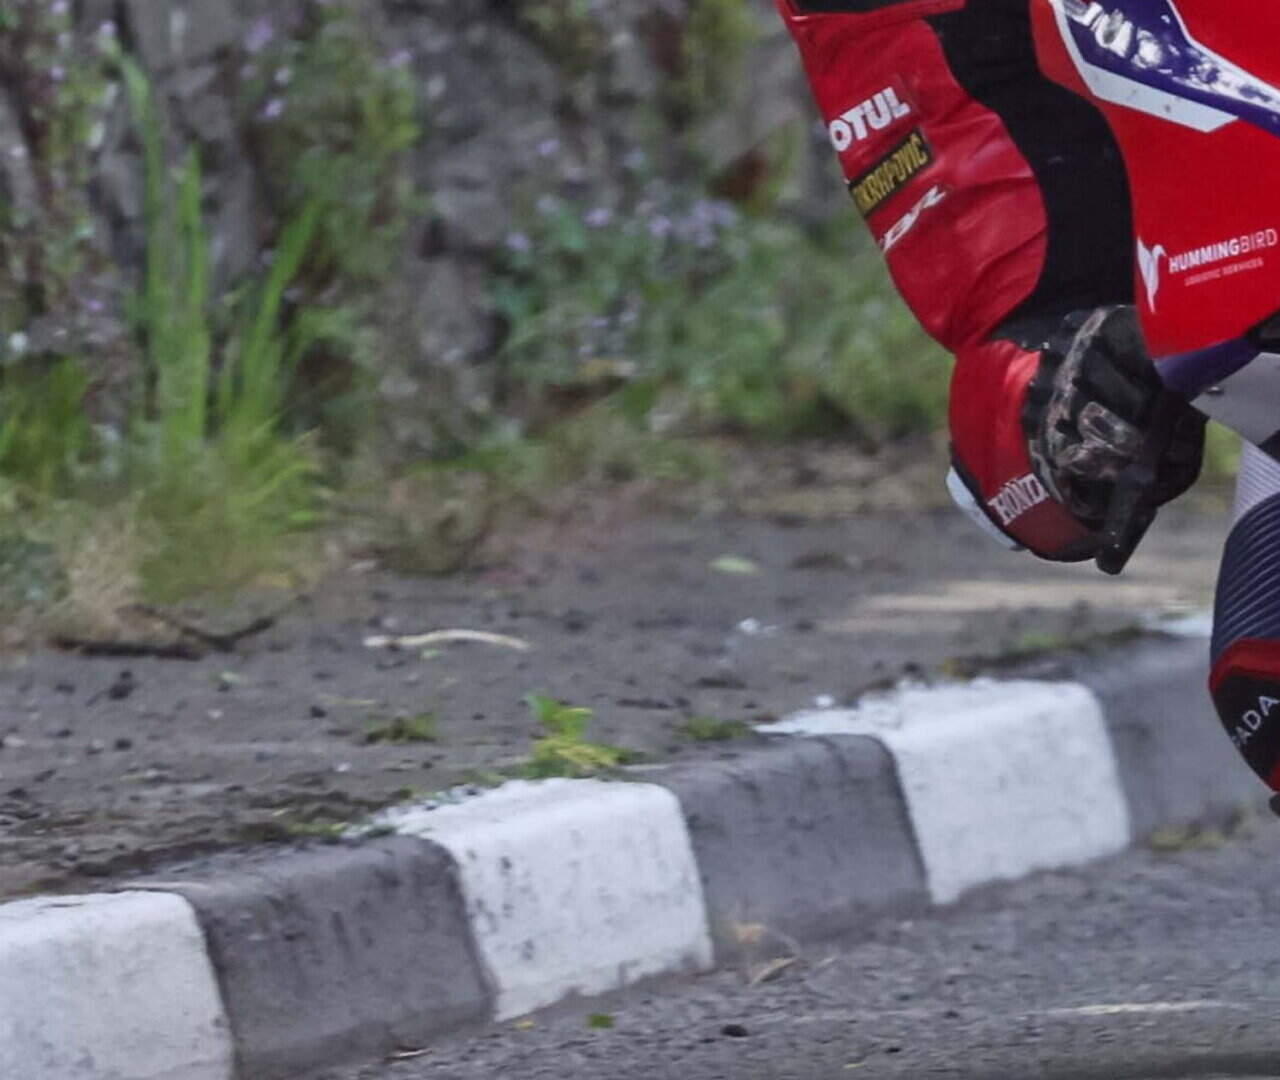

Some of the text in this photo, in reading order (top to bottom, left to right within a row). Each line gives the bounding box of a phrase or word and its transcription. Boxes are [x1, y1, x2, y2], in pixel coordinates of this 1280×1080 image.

[829, 86, 911, 152] OTUL
[1168, 228, 1278, 274] HUMMINGBIRD
[987, 472, 1048, 526] HOND
[1232, 693, 1280, 748] ADA
